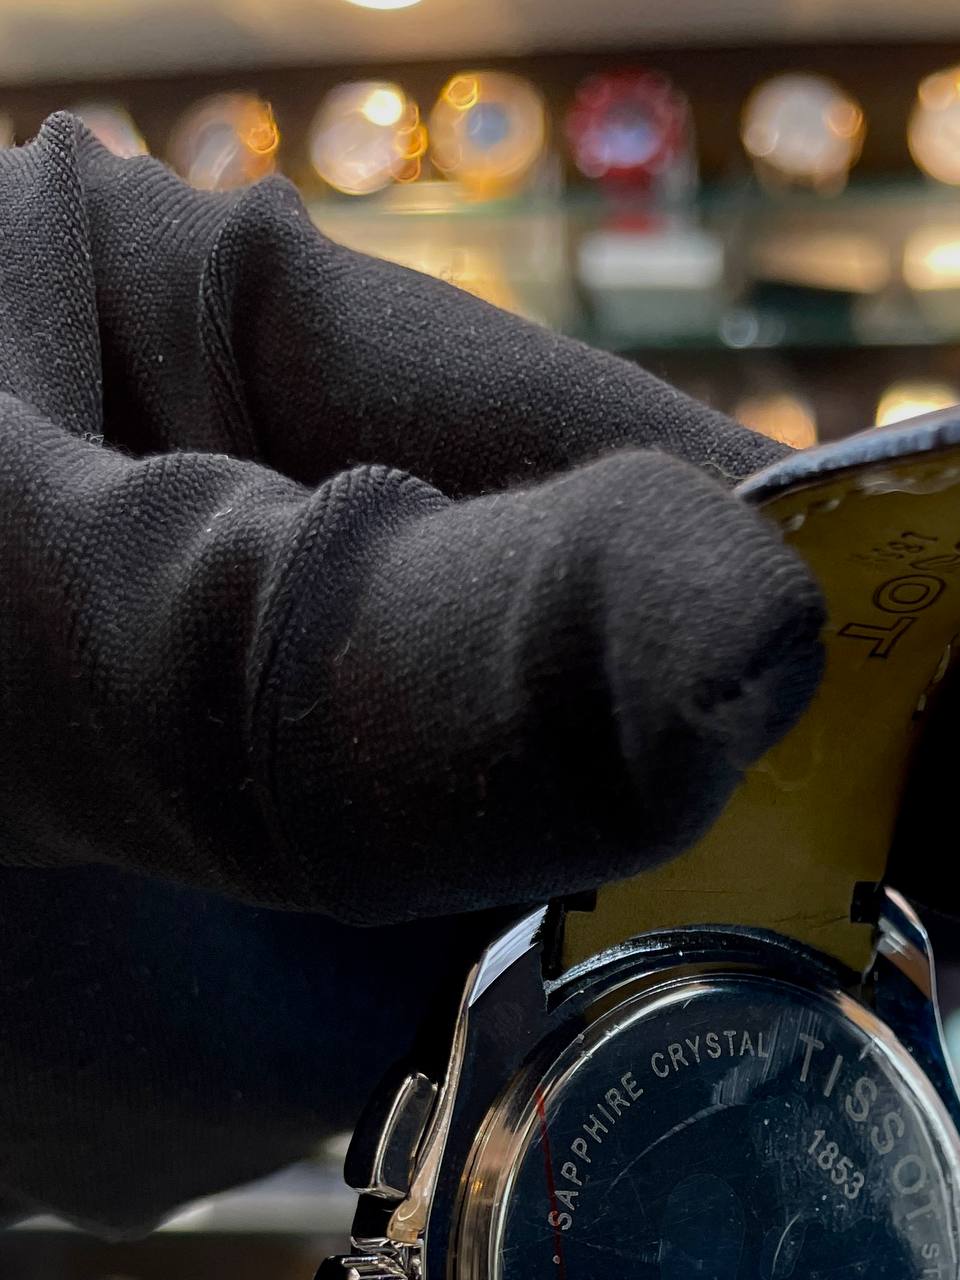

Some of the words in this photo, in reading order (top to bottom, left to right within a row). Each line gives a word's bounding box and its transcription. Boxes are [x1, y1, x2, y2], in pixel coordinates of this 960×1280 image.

[548, 1071, 644, 1231] SAPPHIRE
[651, 1030, 769, 1078] CRYSTAL
[800, 1032, 944, 1221] TISSOT
[807, 1130, 865, 1200] 1853
